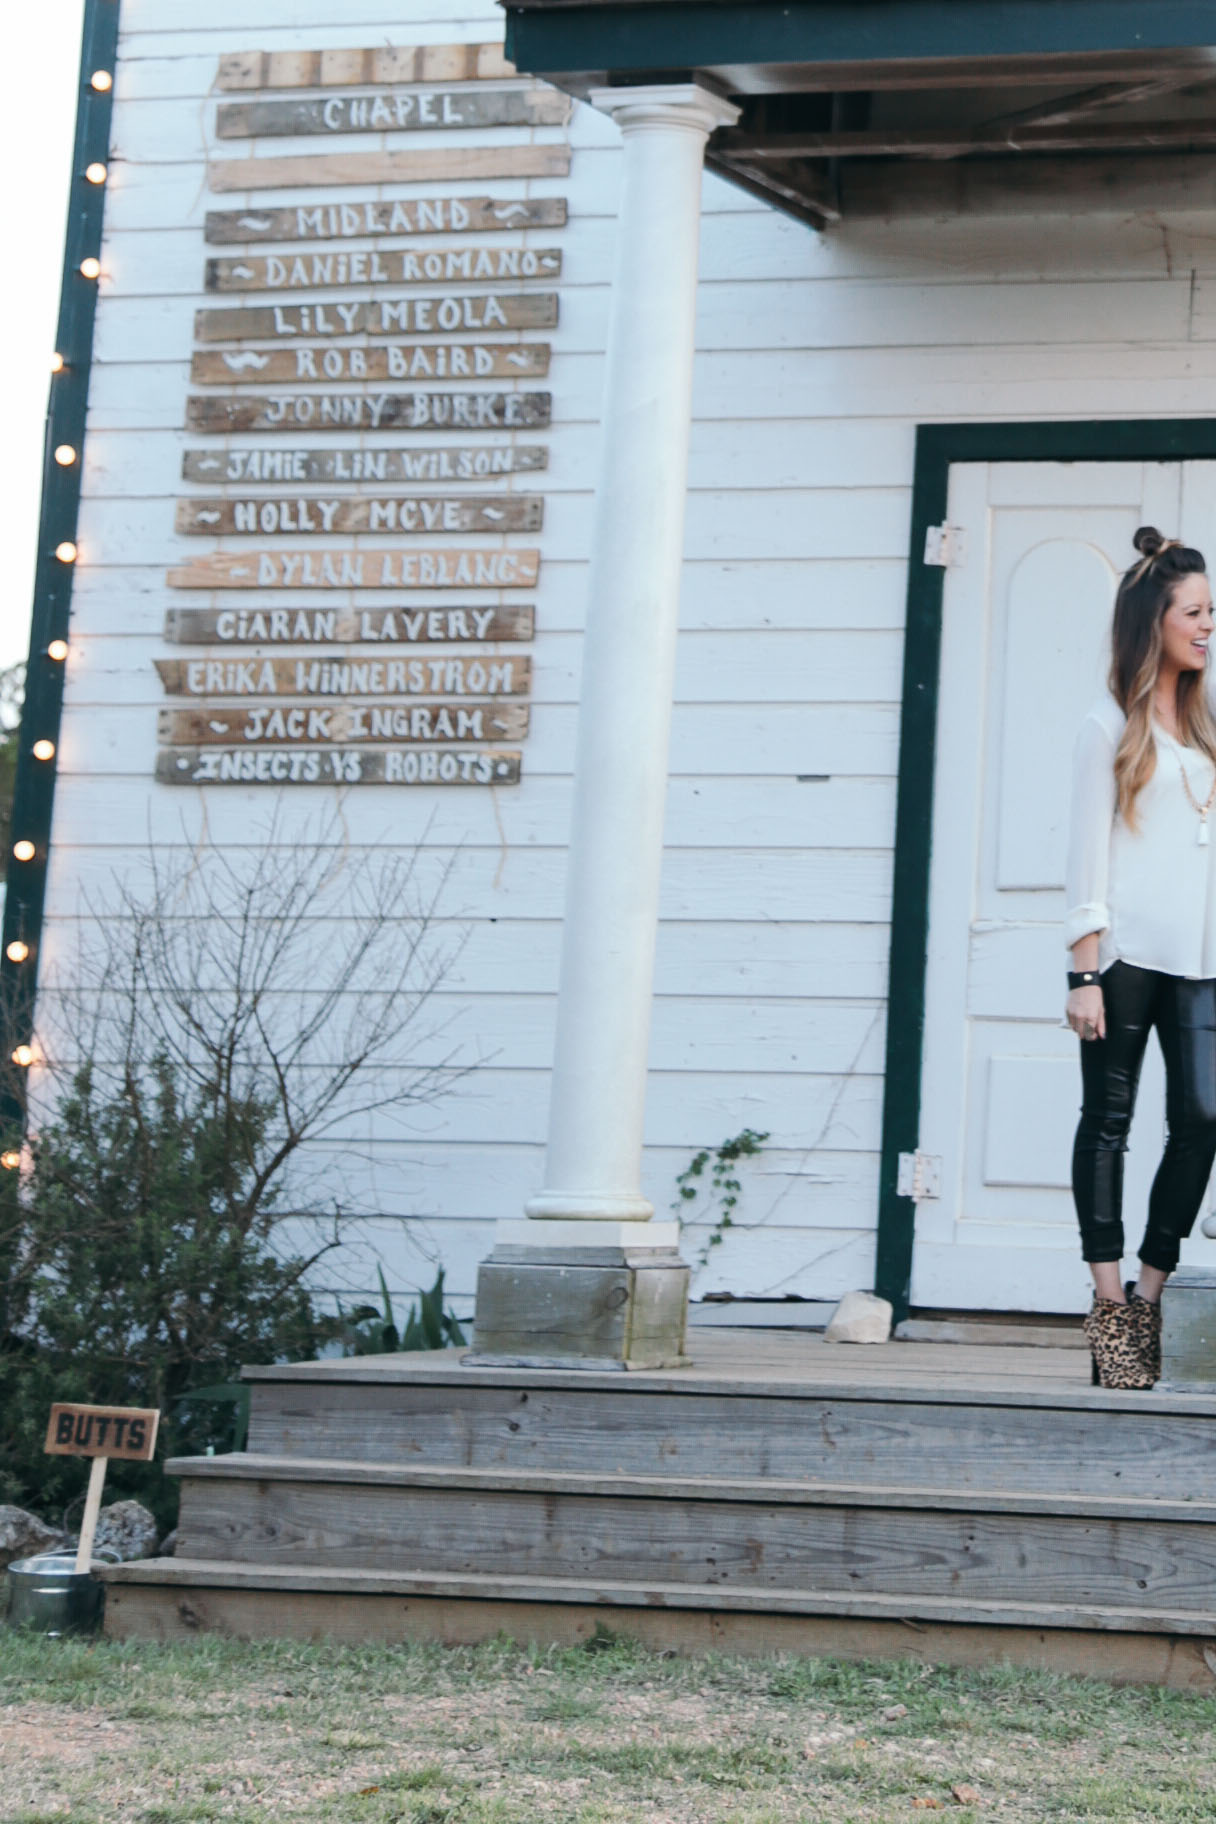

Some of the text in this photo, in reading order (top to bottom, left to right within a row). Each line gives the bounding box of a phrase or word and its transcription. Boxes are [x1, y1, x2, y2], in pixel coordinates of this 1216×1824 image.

[323, 95, 463, 129] CHAPEL
[297, 198, 470, 236] MIDLAND
[403, 249, 537, 280] ROMANO
[381, 297, 507, 330] MEOLA
[296, 348, 366, 377] ROB
[265, 392, 524, 427] JONNY BURKE
[234, 500, 462, 532] HOLLY MCVE
[258, 552, 518, 586] DYLAN LEBLANC
[360, 609, 495, 640] LAVERY
[244, 708, 483, 740] JACK INGRAM
[193, 751, 492, 783] INSECTS VS ROBOTS
[56, 1413, 146, 1450] BUTTS
